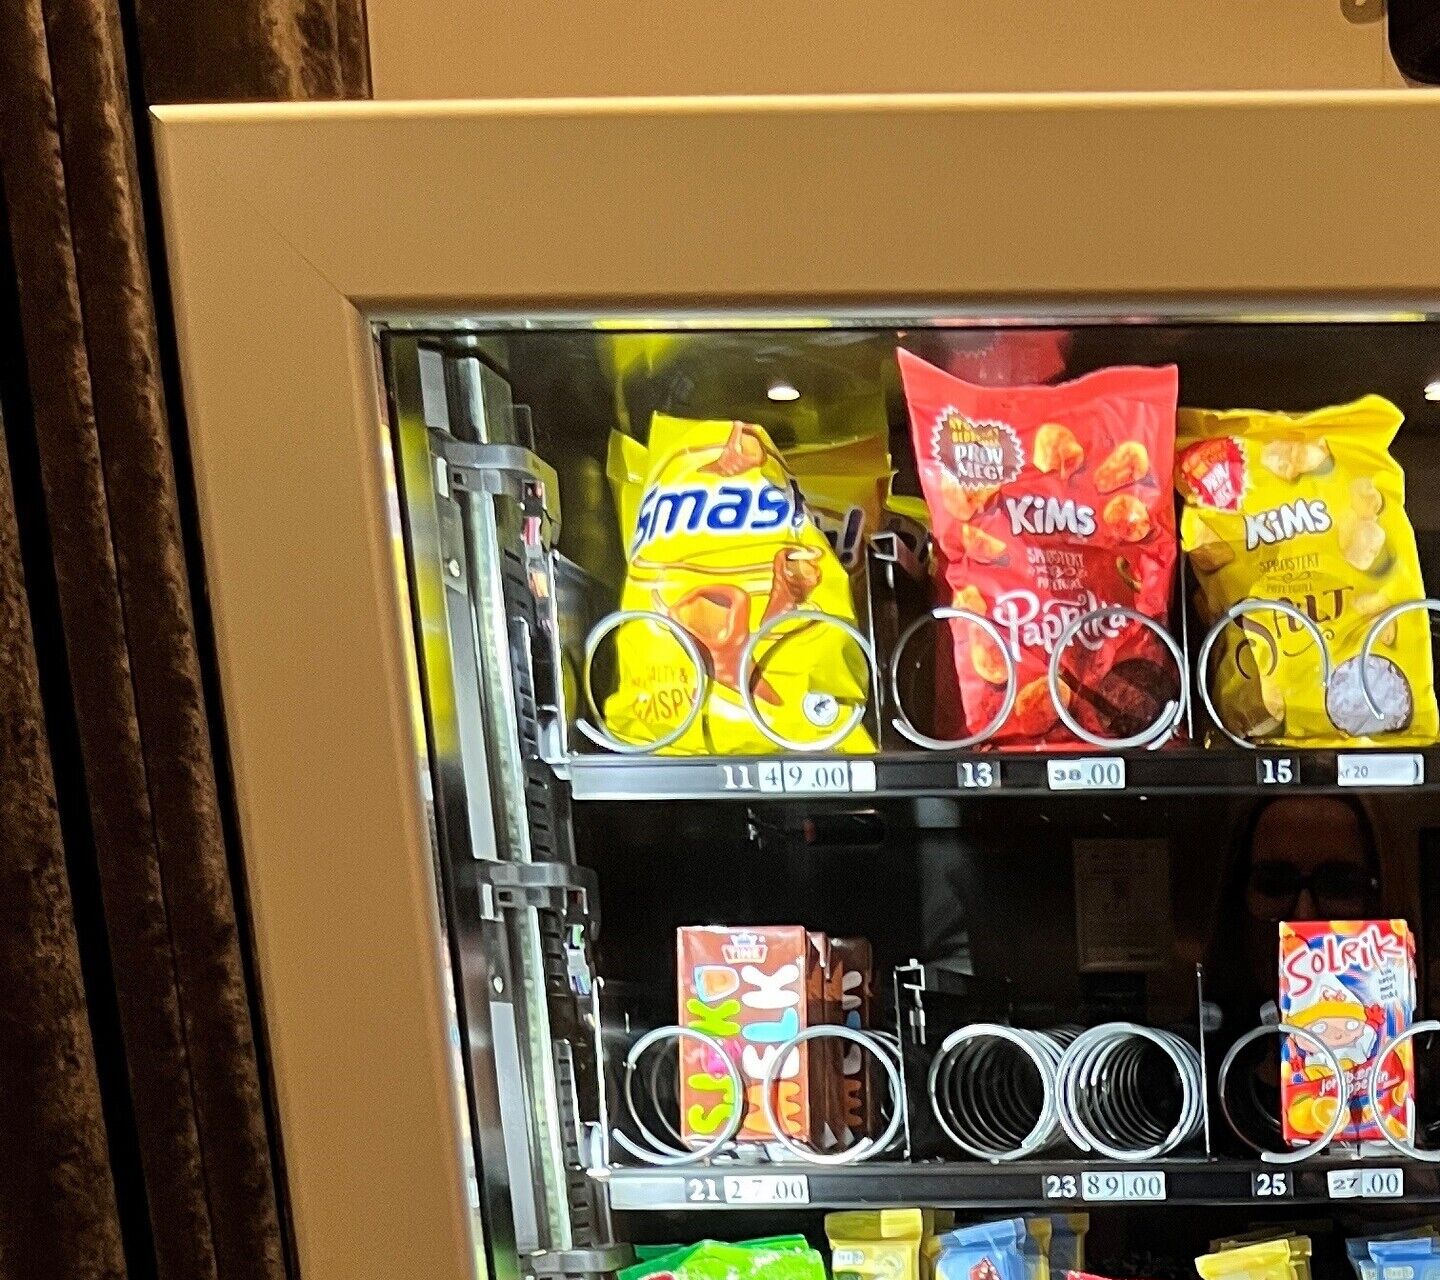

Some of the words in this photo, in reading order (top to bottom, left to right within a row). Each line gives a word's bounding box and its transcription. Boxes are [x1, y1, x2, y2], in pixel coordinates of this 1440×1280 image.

[722, 764, 752, 788] 11
[962, 763, 993, 788] 13
[1262, 759, 1294, 784] 15
[740, 962, 802, 1135] MELK
[689, 1177, 720, 1201] 21
[1047, 1174, 1077, 1198] 23
[1087, 1174, 1162, 1199] 89.00
[1256, 1172, 1287, 1196] 25
[1333, 1174, 1399, 1194] 27.00
